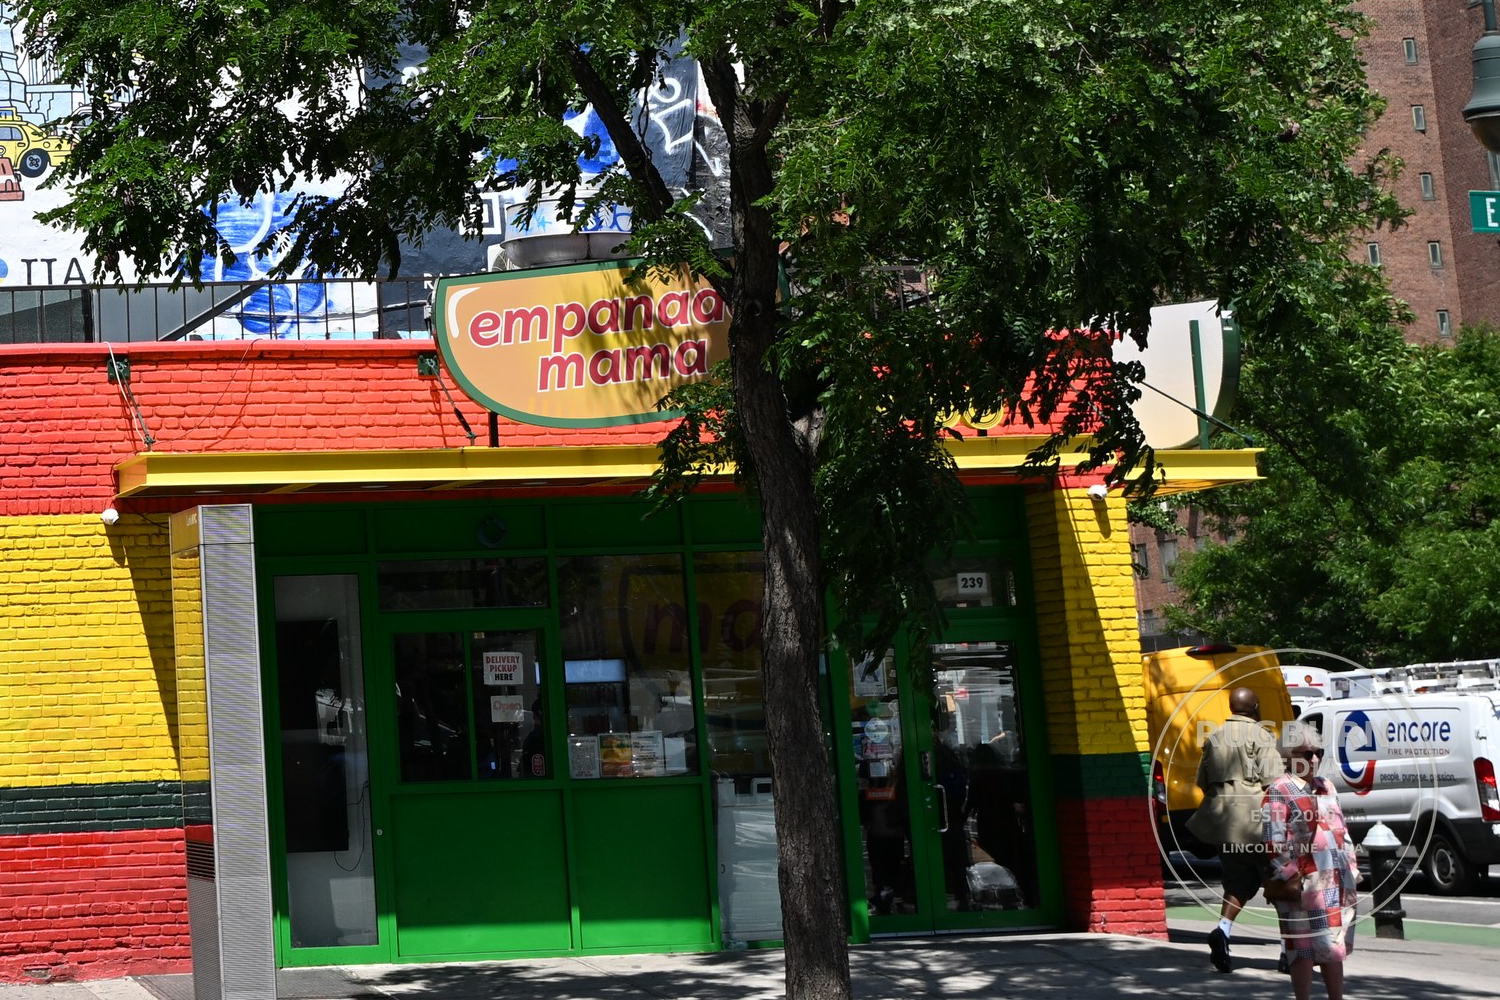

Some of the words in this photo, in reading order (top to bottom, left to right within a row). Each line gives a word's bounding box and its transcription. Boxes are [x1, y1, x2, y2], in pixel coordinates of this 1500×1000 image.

[1486, 198, 1498, 227] E
[468, 287, 734, 353] empanad
[537, 338, 710, 393] mama
[961, 576, 984, 589] 239
[486, 655, 520, 664] DELIVERY
[489, 664, 518, 672] PICKUP
[494, 673, 513, 681] HERE
[1386, 720, 1451, 743] encore
[1388, 748, 1402, 756] FIRE
[1405, 748, 1450, 756] PROTECTION
